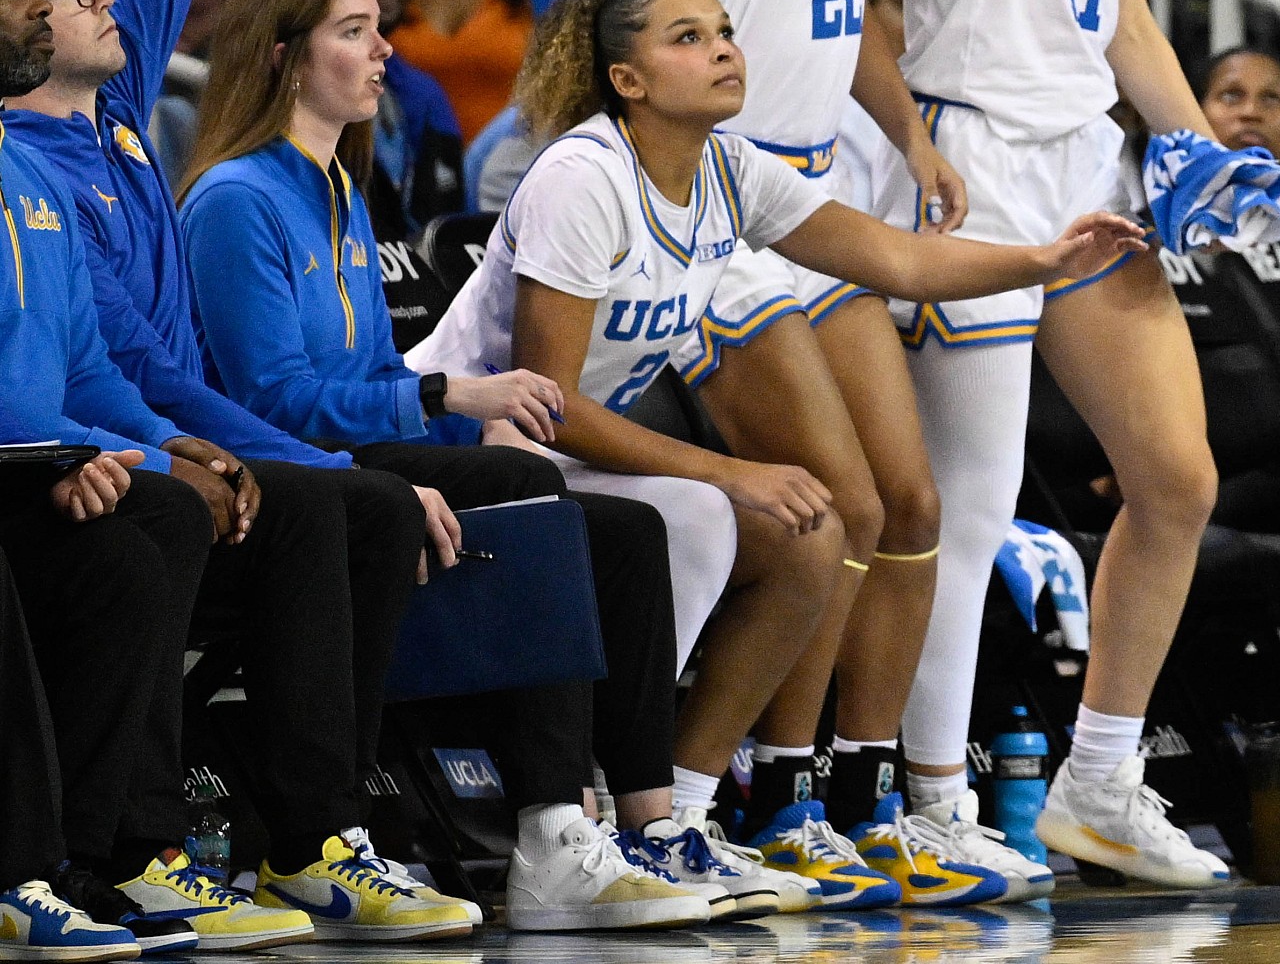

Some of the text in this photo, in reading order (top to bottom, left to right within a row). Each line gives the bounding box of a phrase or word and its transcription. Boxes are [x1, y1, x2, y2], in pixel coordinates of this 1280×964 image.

[604, 293, 699, 342] UCL
[604, 349, 670, 416] 2
[446, 760, 498, 787] UCLA
